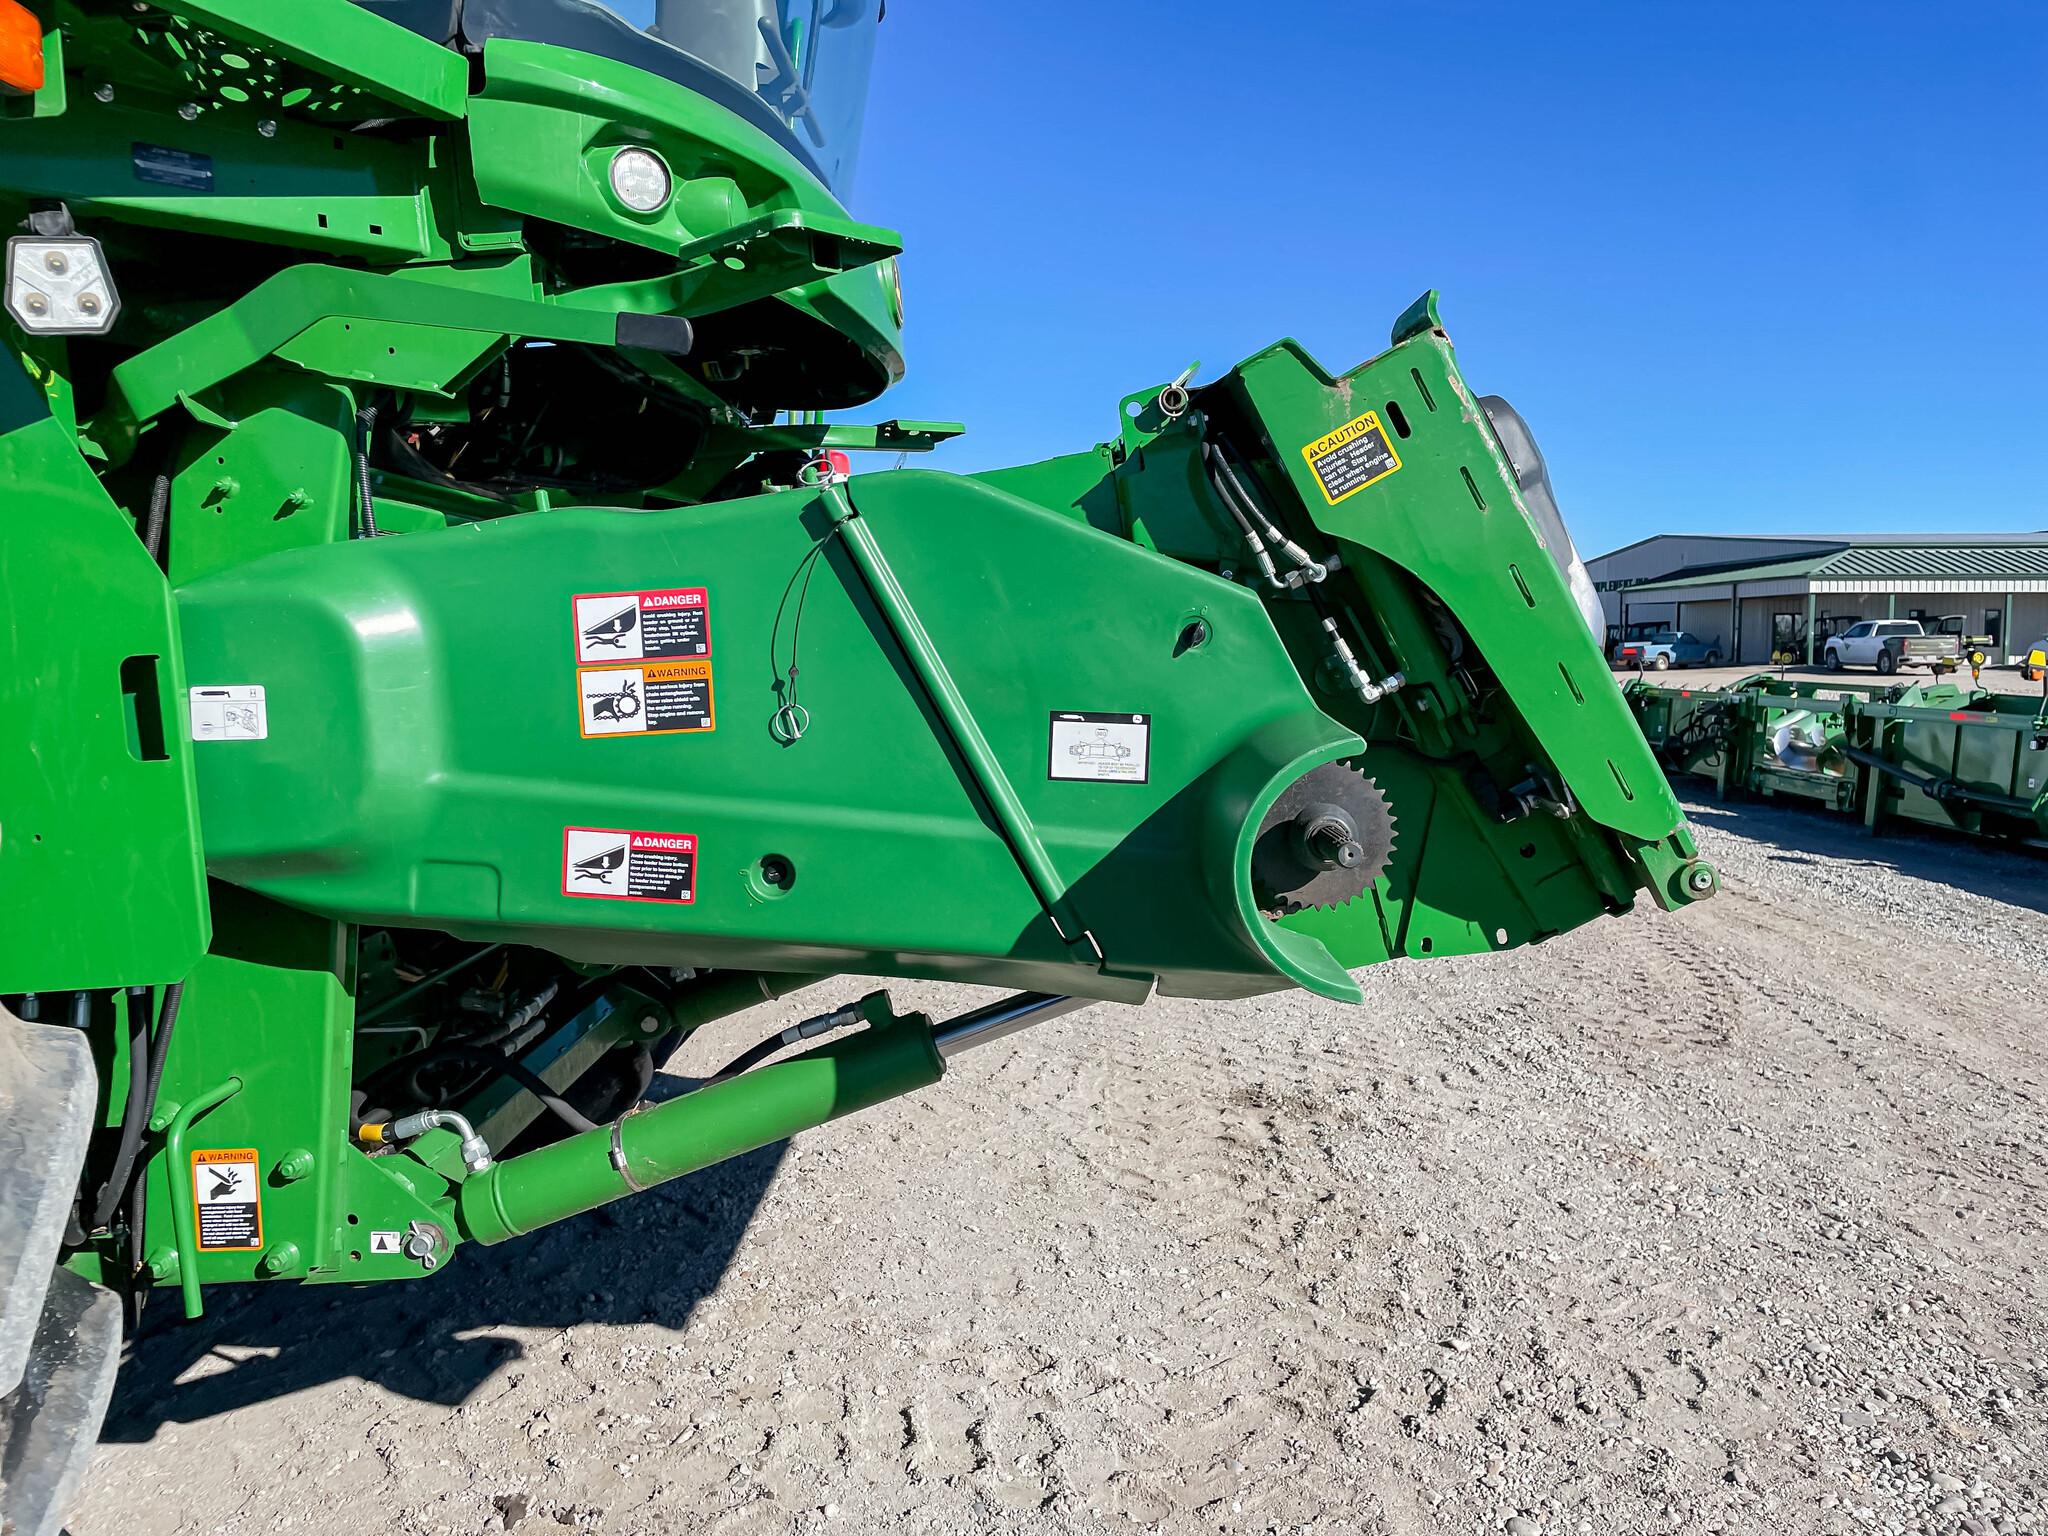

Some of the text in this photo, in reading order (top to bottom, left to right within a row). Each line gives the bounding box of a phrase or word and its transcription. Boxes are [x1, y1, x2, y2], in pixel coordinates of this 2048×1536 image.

[1318, 415, 1375, 452] CAUTION
[1317, 437, 1368, 468] Avoid crushing
[1350, 442, 1374, 458] Header
[1324, 455, 1367, 481] can tilt. Stay
[1328, 453, 1388, 488] clear when engine
[1339, 474, 1368, 491] running.
[654, 594, 701, 606] DANGER
[657, 667, 706, 677] WARNING
[644, 837, 691, 849] DANGER
